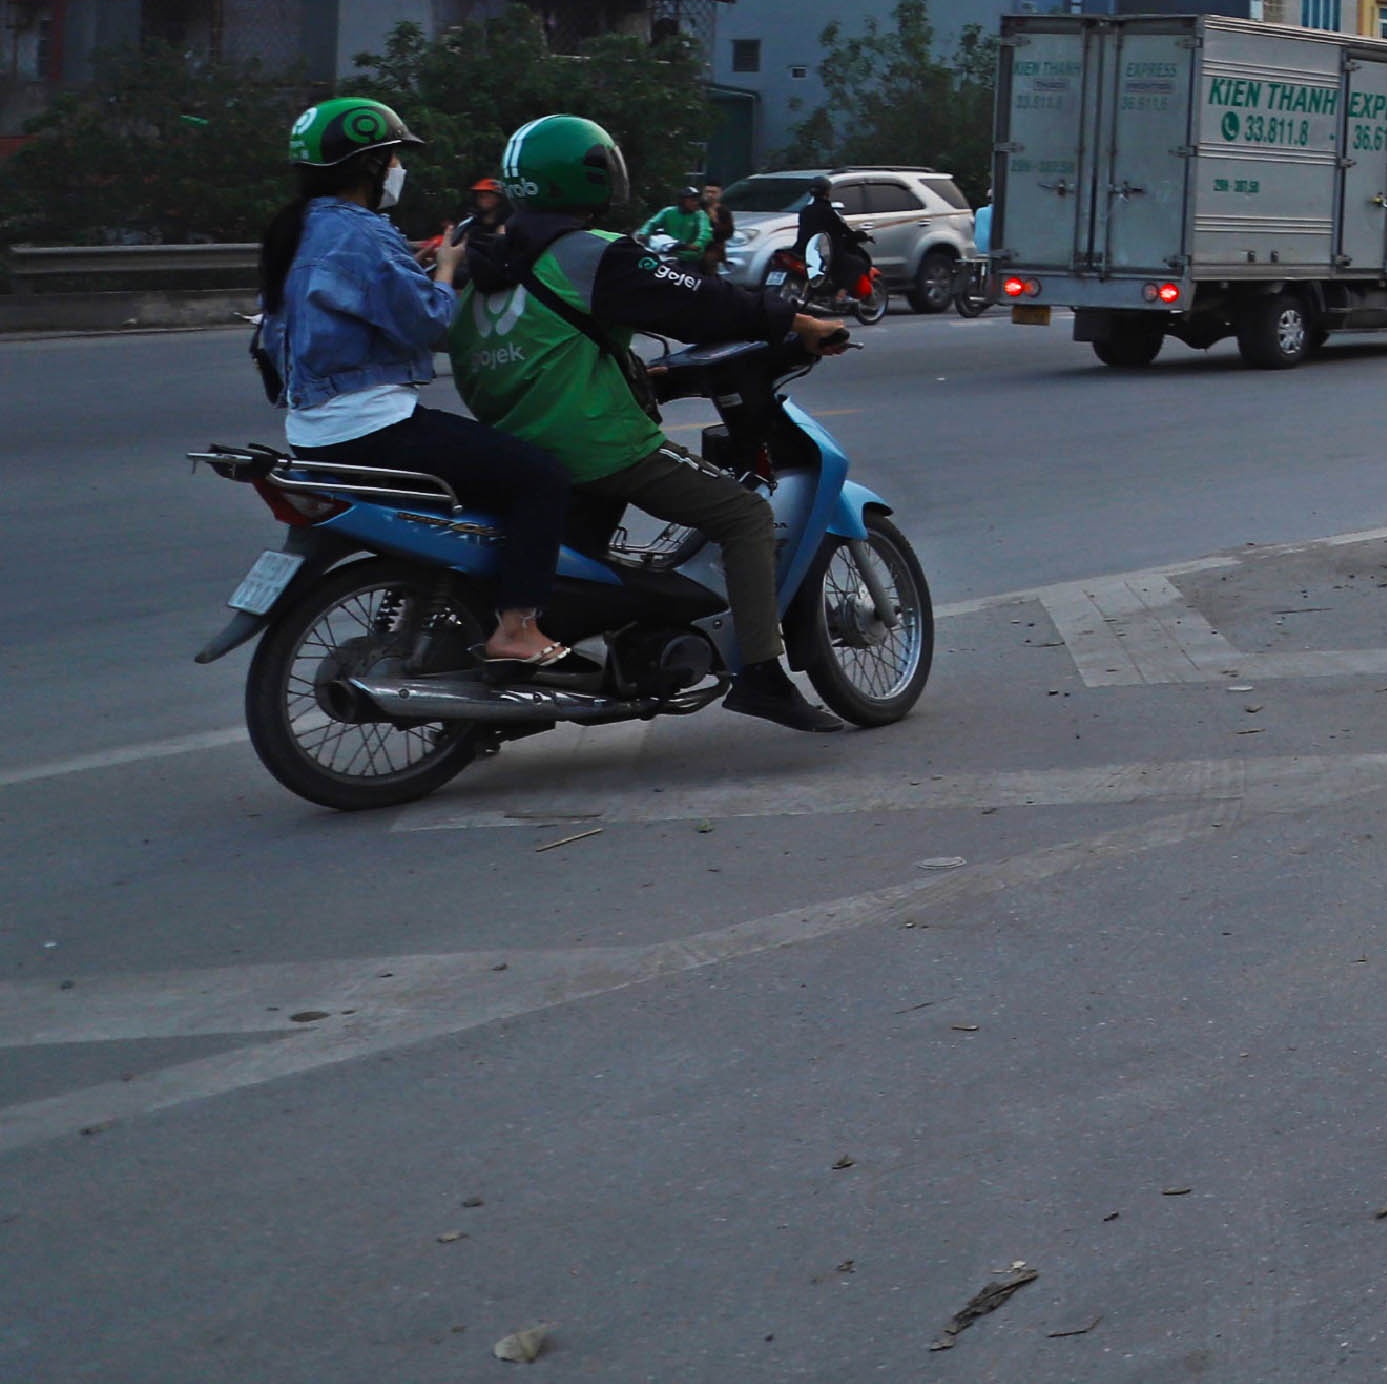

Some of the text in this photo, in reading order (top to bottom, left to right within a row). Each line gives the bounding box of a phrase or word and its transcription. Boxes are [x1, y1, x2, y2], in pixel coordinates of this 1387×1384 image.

[1126, 62, 1177, 78] EXPRESS
[1208, 78, 1262, 107] KIEN
[1266, 83, 1337, 116] THANH
[1244, 115, 1309, 146] 33.811.8
